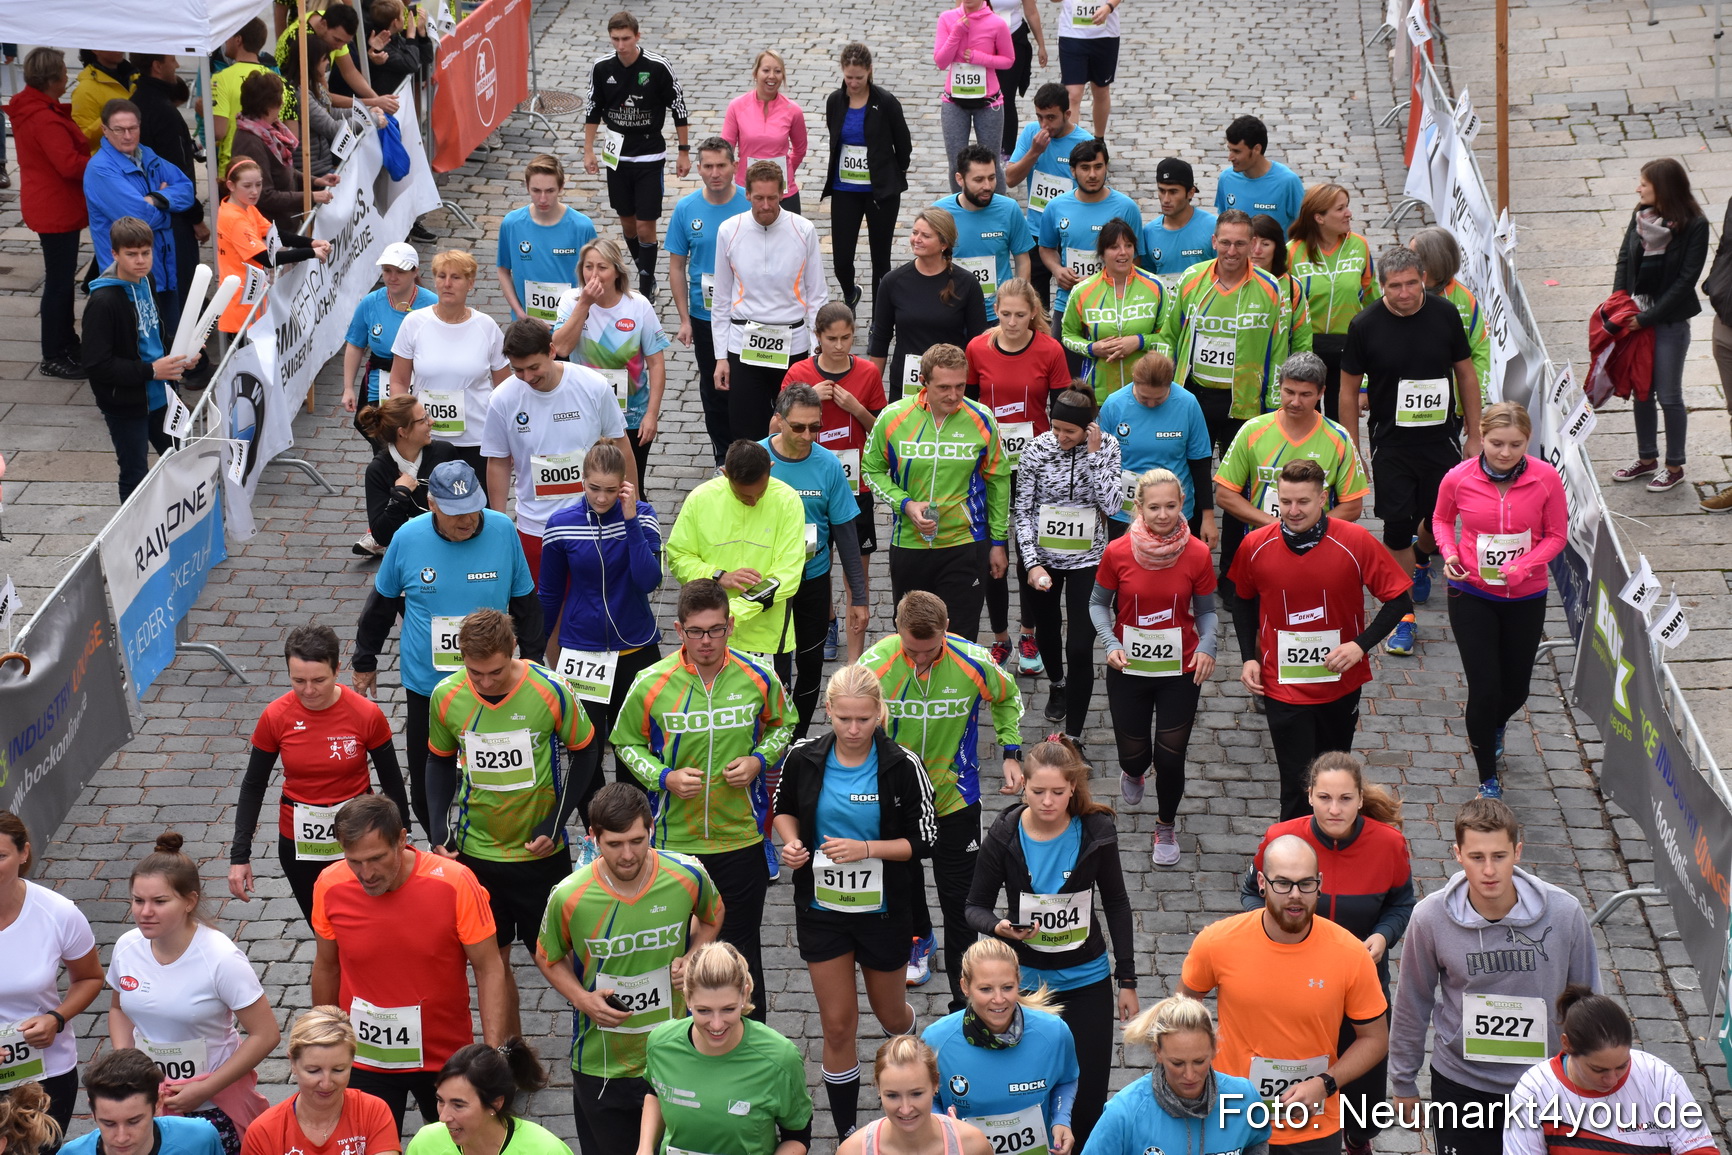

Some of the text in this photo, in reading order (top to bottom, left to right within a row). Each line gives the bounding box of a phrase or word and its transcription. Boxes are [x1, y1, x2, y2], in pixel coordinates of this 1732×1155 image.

[955, 73, 981, 85] 5159
[337, 133, 352, 153] swn
[844, 156, 870, 170] 5043
[247, 278, 257, 300] swn
[1085, 302, 1156, 324] BOCK
[749, 335, 784, 351] 5028
[1200, 349, 1235, 366] 5219
[1405, 394, 1441, 409] 5164
[1553, 378, 1568, 405] swn
[170, 404, 183, 433] swn
[553, 411, 581, 420] BOCK
[1569, 411, 1589, 437] swn
[1155, 431, 1183, 439] BOCK
[899, 441, 977, 460] BOCK
[541, 465, 581, 483] 8005
[135, 480, 208, 580] RAILONE
[1047, 521, 1085, 538] 5211
[467, 571, 498, 580] BOCK
[1632, 582, 1649, 605] sw
[1147, 614, 1164, 623] DEHN
[1298, 611, 1316, 621] DEHN
[1661, 610, 1684, 640] swn
[135, 606, 168, 661] JEDER
[1131, 643, 1174, 660] 5242
[564, 658, 606, 681] 5174
[885, 696, 971, 719] BOCK
[662, 703, 757, 734] BOCK
[476, 748, 523, 769] 5230
[303, 823, 337, 840] 524
[824, 869, 872, 889] 5117
[1030, 906, 1080, 930] 5084
[584, 921, 684, 959] BOCK
[1041, 933, 1070, 942] Barbara
[1466, 949, 1537, 976] PUMA
[625, 977, 650, 988] BOCK
[613, 987, 660, 1012] 234
[358, 1020, 410, 1045] 5214
[1475, 1014, 1535, 1038] 5227
[0, 1070, 16, 1080] aria
[155, 1060, 196, 1080] 009
[1009, 1079, 1047, 1092] BOCK
[1260, 1076, 1315, 1097] 52
[337, 1138, 348, 1146] TSV
